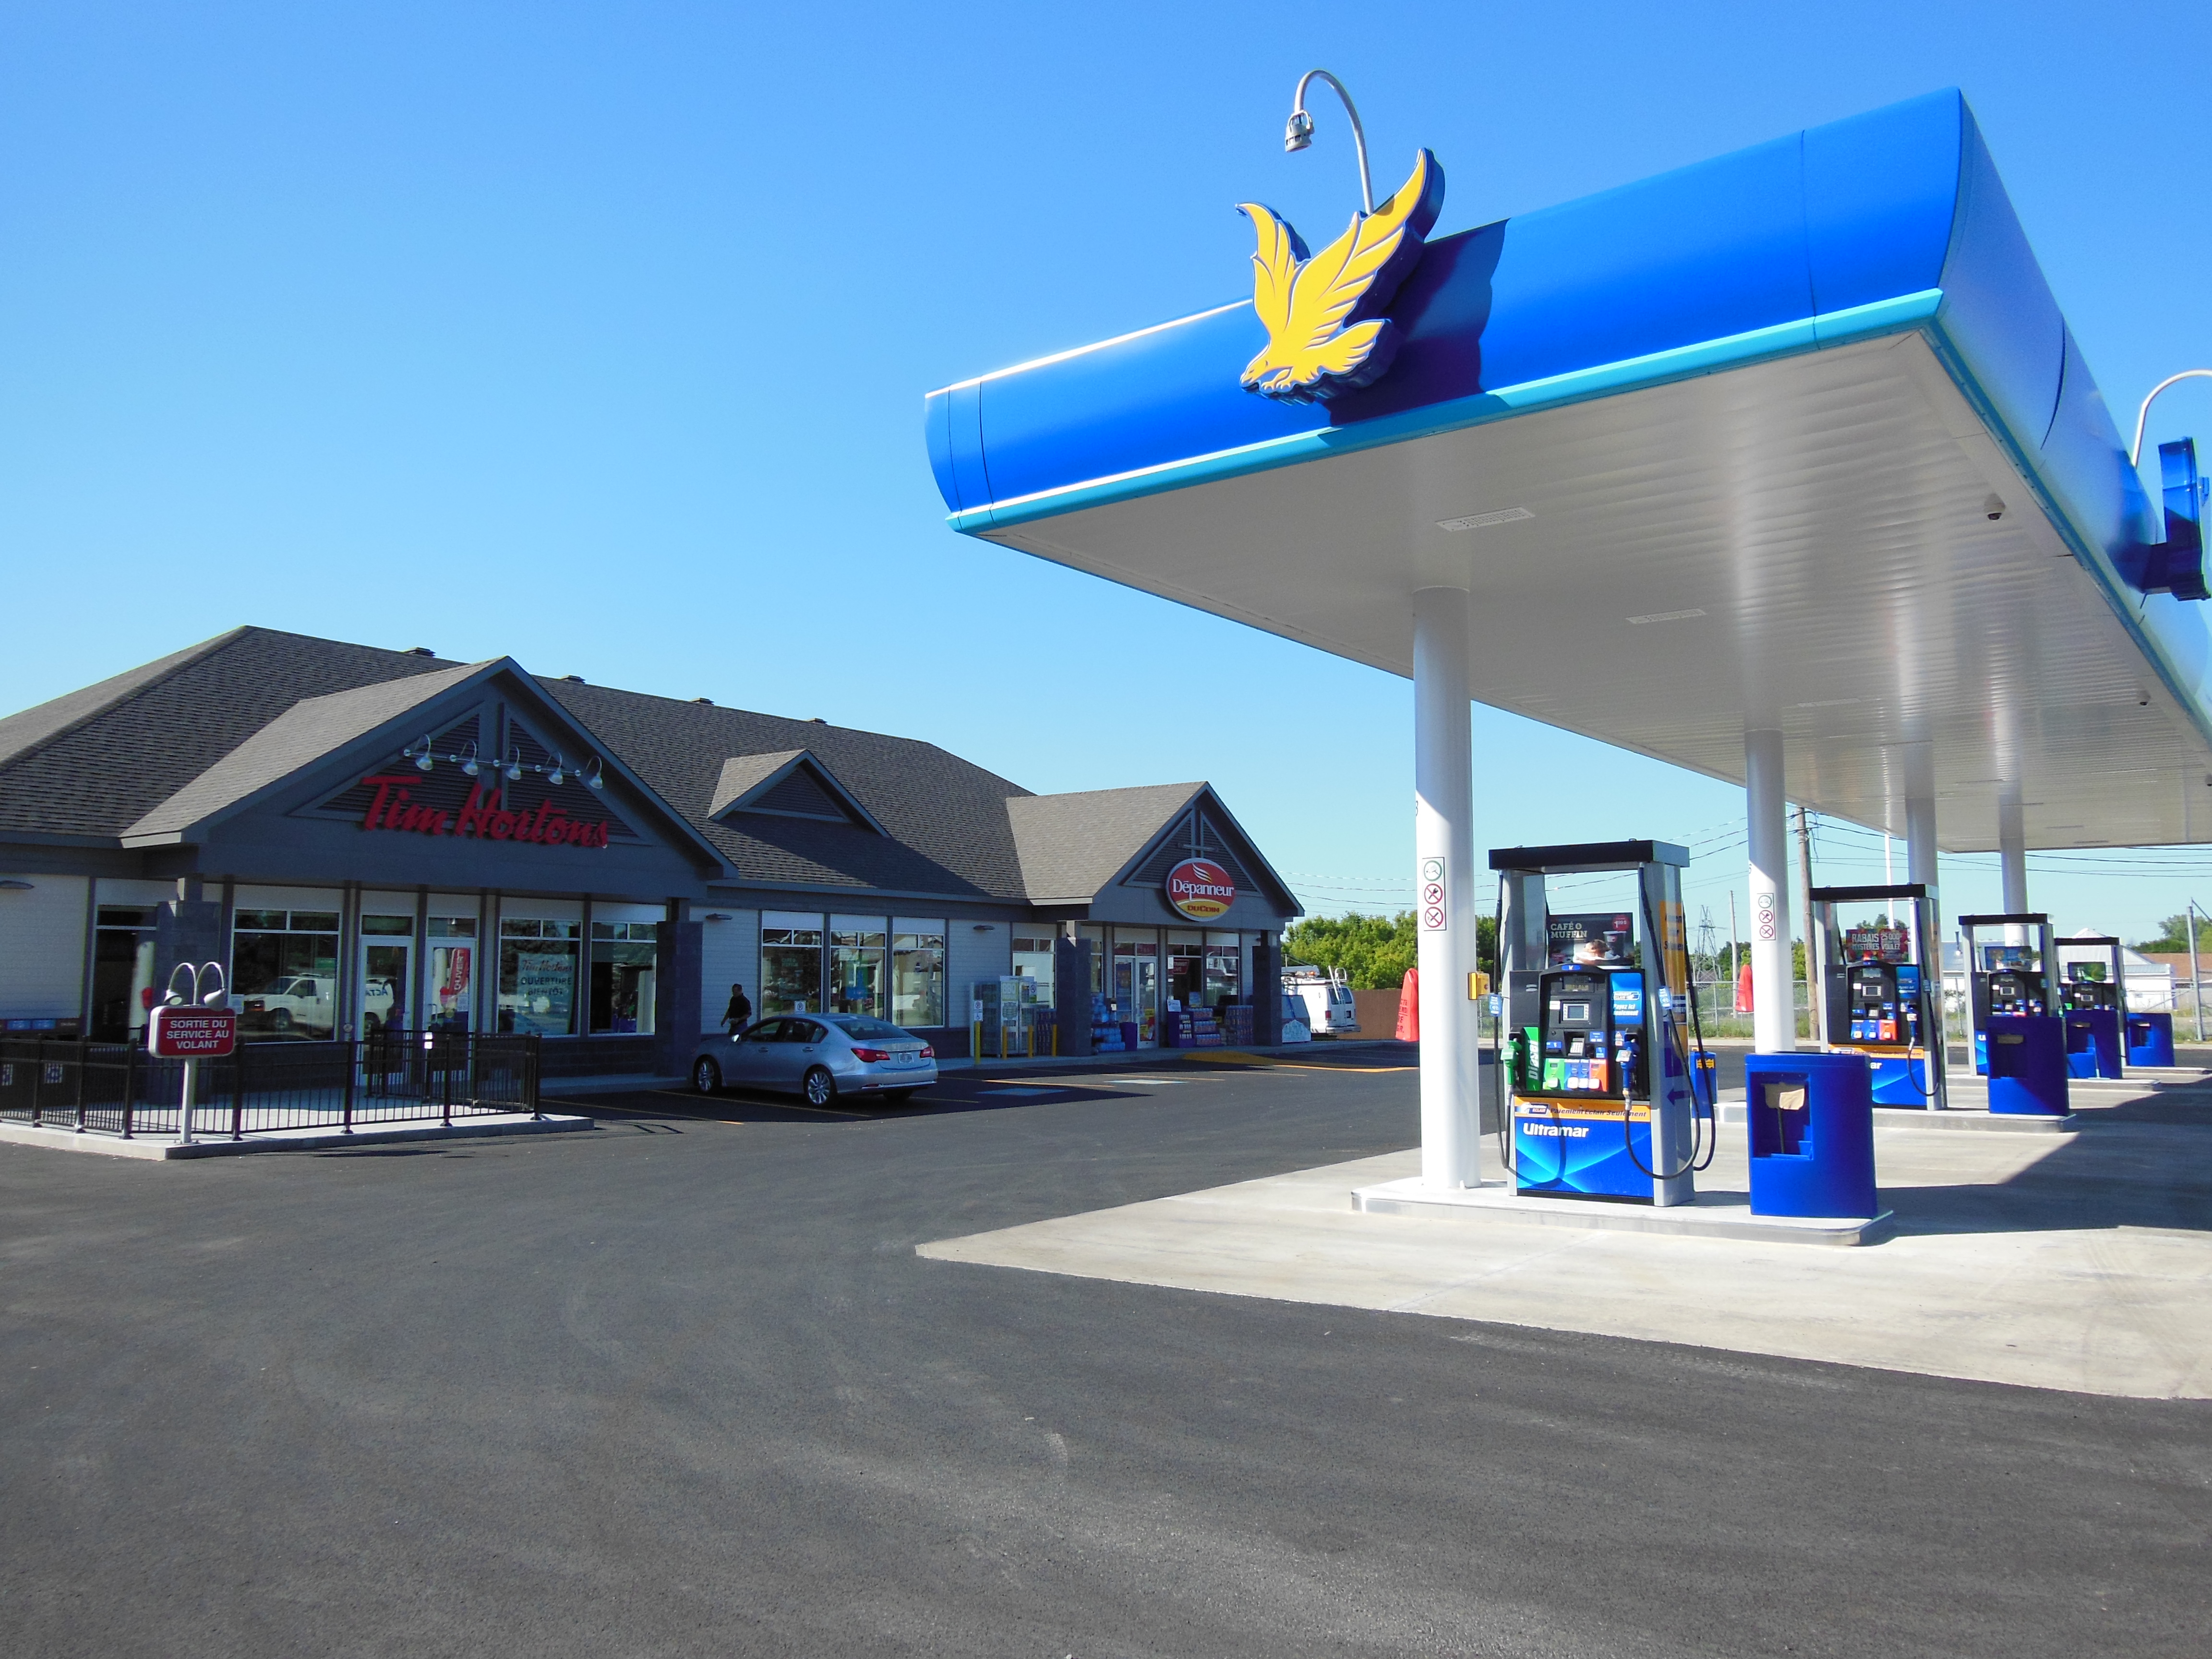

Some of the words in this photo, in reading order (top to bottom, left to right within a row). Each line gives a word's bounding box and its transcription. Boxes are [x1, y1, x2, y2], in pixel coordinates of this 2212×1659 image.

[362, 776, 448, 835] Tim
[454, 782, 608, 847] Hortons
[1173, 878, 1234, 901] Dépanneur
[1551, 922, 1574, 930] CAFÉ
[1551, 930, 1587, 938] MUFFIN
[1851, 933, 1879, 942] RABAIS
[455, 950, 464, 990] OUVERT
[522, 960, 538, 971] Tim
[170, 1020, 209, 1028] SORTIE
[166, 1030, 213, 1039] SERVICE
[177, 1040, 219, 1049] VOLANT
[1523, 1122, 1589, 1138] Ultramar
